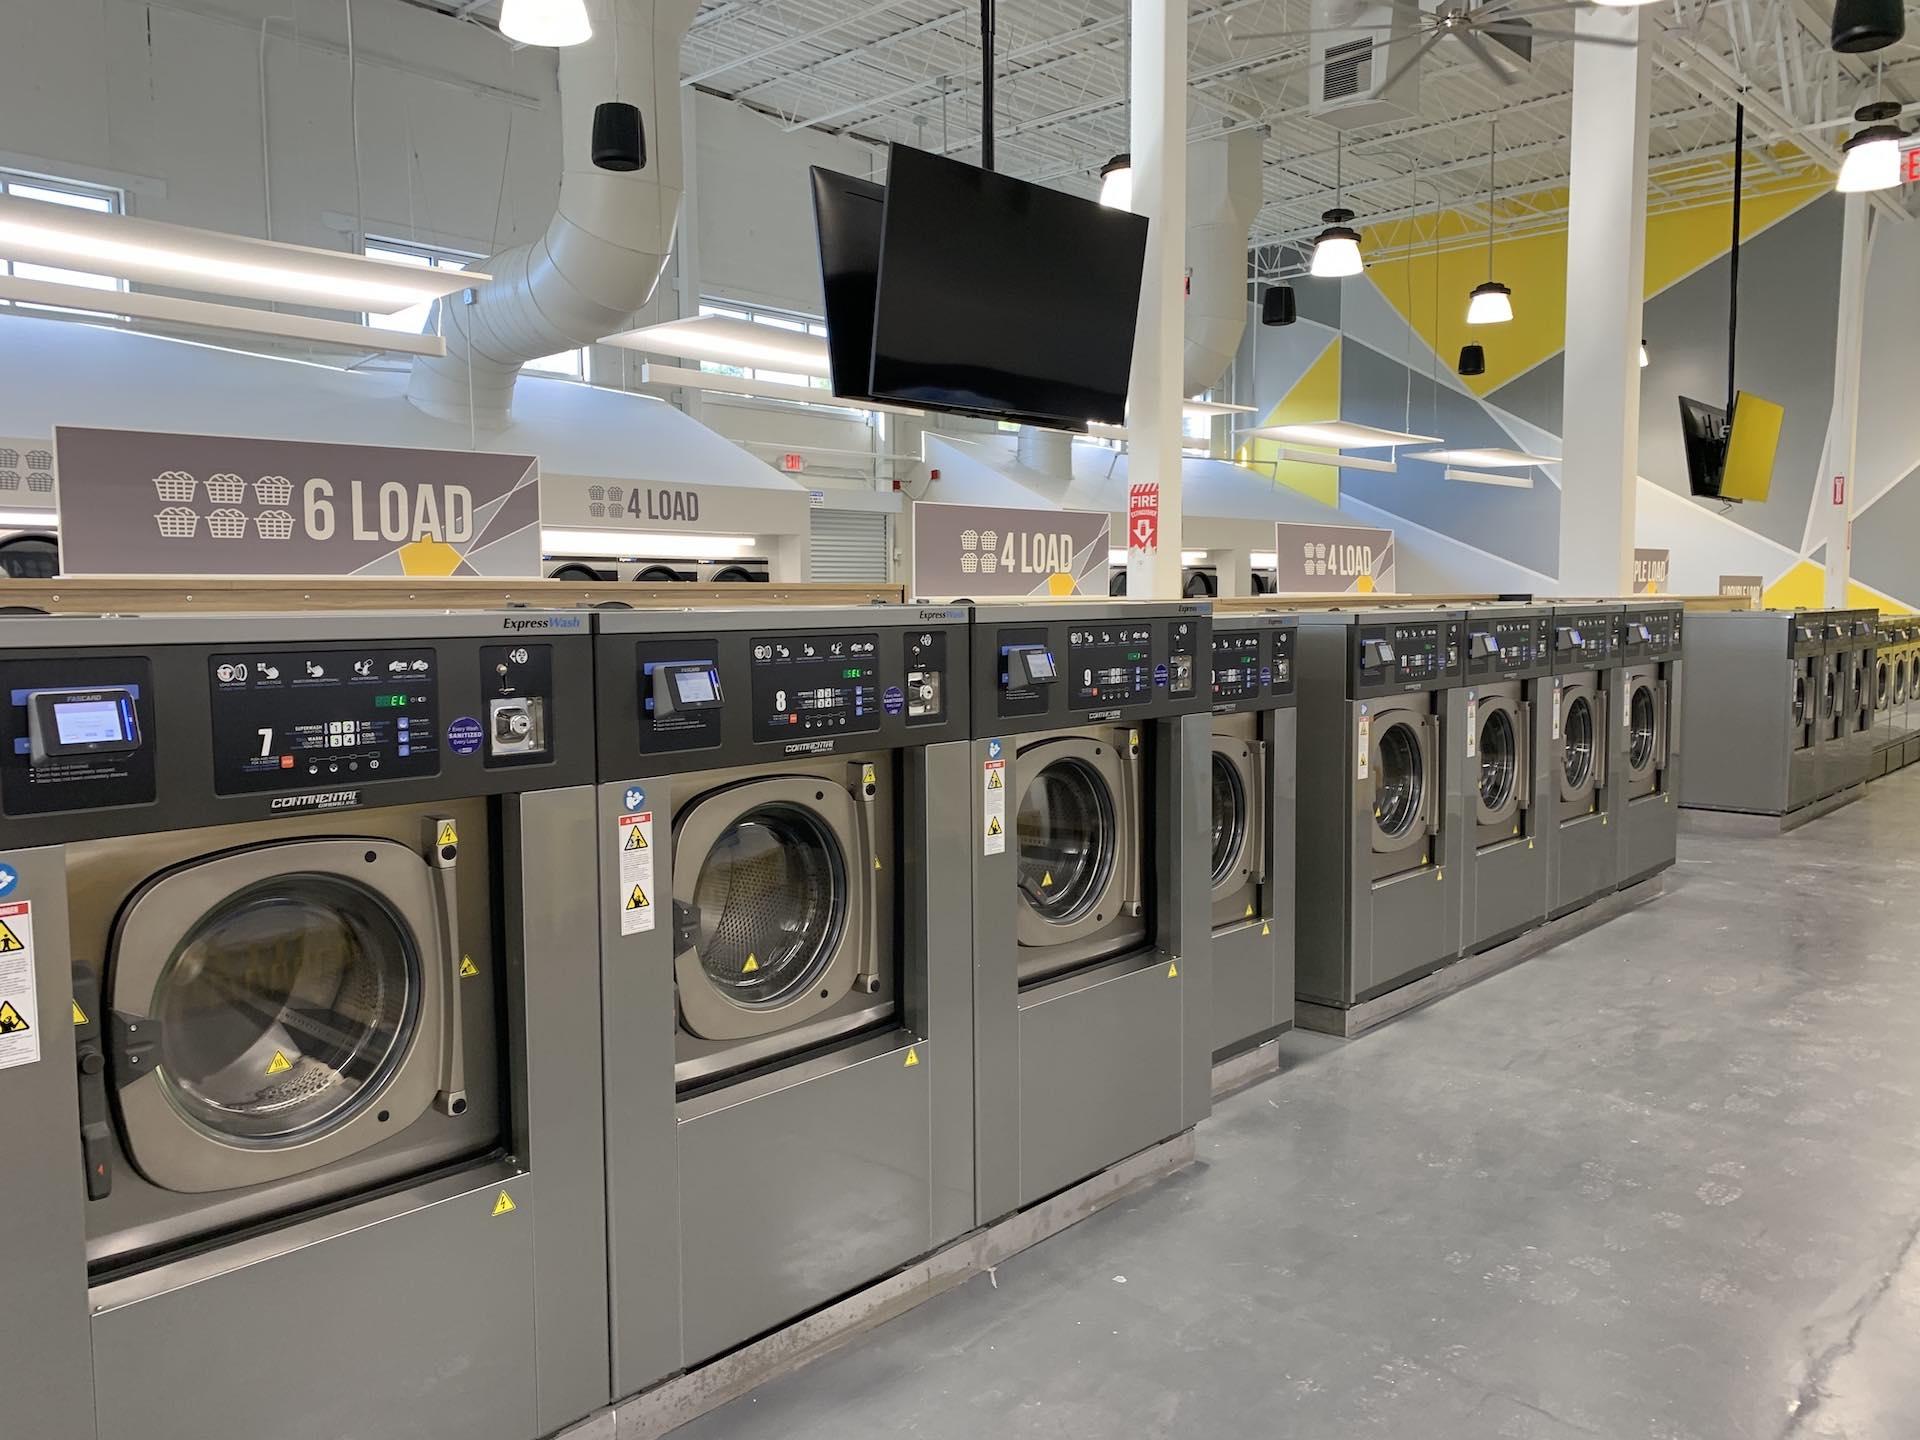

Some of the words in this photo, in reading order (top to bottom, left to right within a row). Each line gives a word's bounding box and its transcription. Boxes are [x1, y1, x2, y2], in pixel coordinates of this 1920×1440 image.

[303, 478, 336, 541] 6
[351, 480, 473, 543] LOAD
[627, 488, 642, 519] 4
[647, 489, 699, 521] LOAD
[1131, 494, 1157, 508] FIRE
[1000, 532, 1016, 573] 4
[1021, 532, 1073, 574] LOAD
[1328, 544, 1337, 575] 4
[1340, 544, 1372, 576] LOAD
[1648, 560, 1666, 582] LOAD
[503, 616, 581, 631] ExpressWash
[1083, 669, 1092, 686] 9
[776, 690, 787, 711] 8
[257, 728, 273, 757] 7
[271, 791, 360, 808] CONTINENTAL
